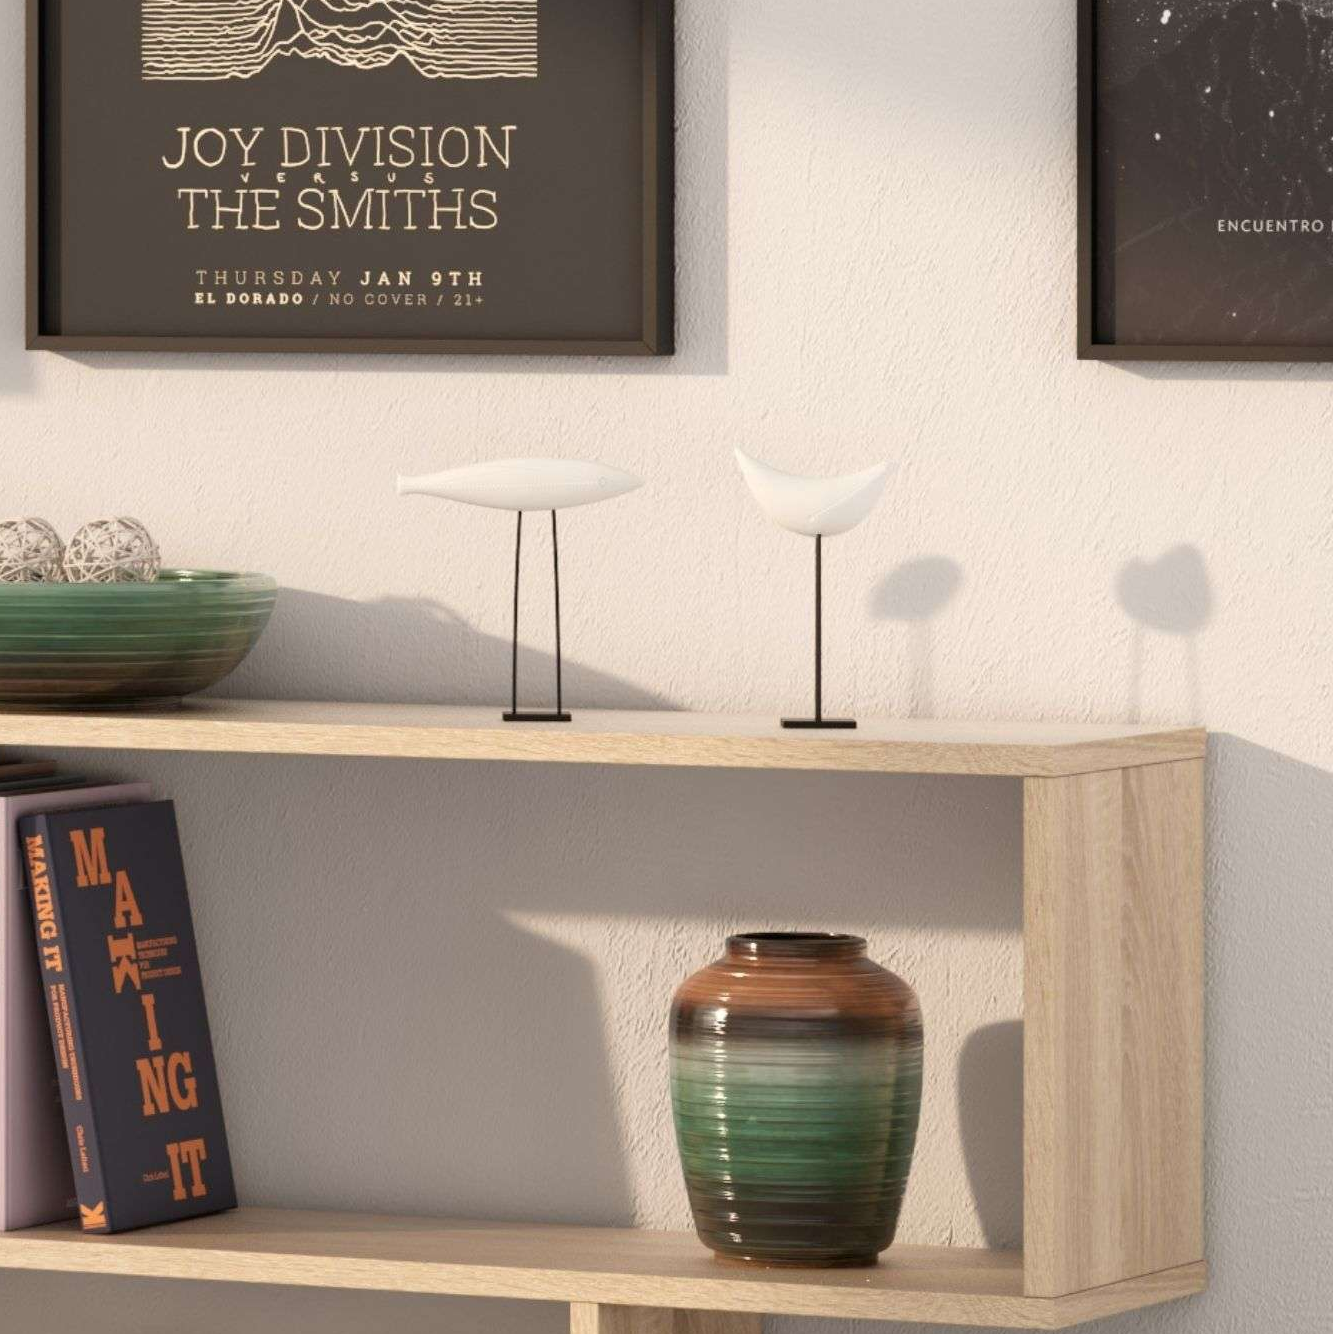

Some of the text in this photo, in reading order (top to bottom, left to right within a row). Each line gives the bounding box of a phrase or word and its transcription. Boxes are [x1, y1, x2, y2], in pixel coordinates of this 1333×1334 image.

[162, 125, 517, 169] JOY DIVISION
[240, 171, 435, 185] VERSUS
[177, 188, 499, 231] THE SMITHS
[1217, 219, 1325, 233] ENCUENTRO
[195, 270, 483, 287] THURSDAY JAN 9TH
[194, 292, 484, 307] EL DORADO NO COVER 21+
[25, 835, 64, 972] MAKING IT
[166, 1138, 208, 1201] IT
